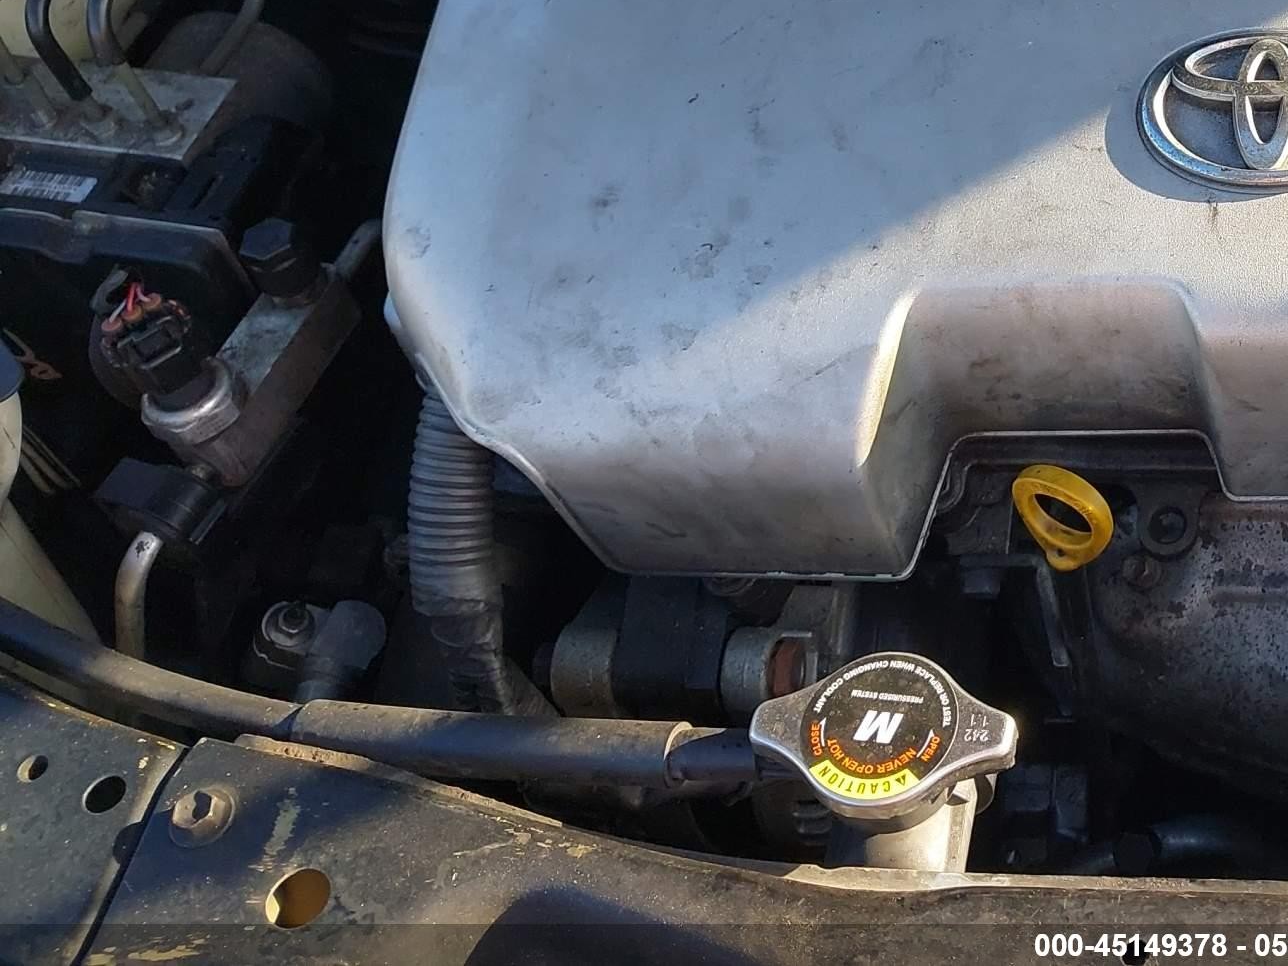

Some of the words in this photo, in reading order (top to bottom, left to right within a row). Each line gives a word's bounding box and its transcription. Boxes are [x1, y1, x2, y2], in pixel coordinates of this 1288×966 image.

[843, 660, 888, 680] CHANGING
[890, 660, 914, 672] WHEN
[916, 665, 943, 694] REPLACE
[813, 678, 843, 712] COOLANT
[851, 689, 878, 699] SYSTEM
[879, 692, 924, 703] PRESSURISED
[940, 693, 950, 705] OR
[853, 710, 904, 743] M
[943, 706, 951, 727] TEST
[810, 723, 822, 755] CLOSE
[828, 737, 842, 759] HOT
[920, 736, 940, 761] OPEN
[842, 758, 874, 774] OPEN
[876, 747, 917, 773] NEVER
[818, 766, 891, 793] CAUTION
